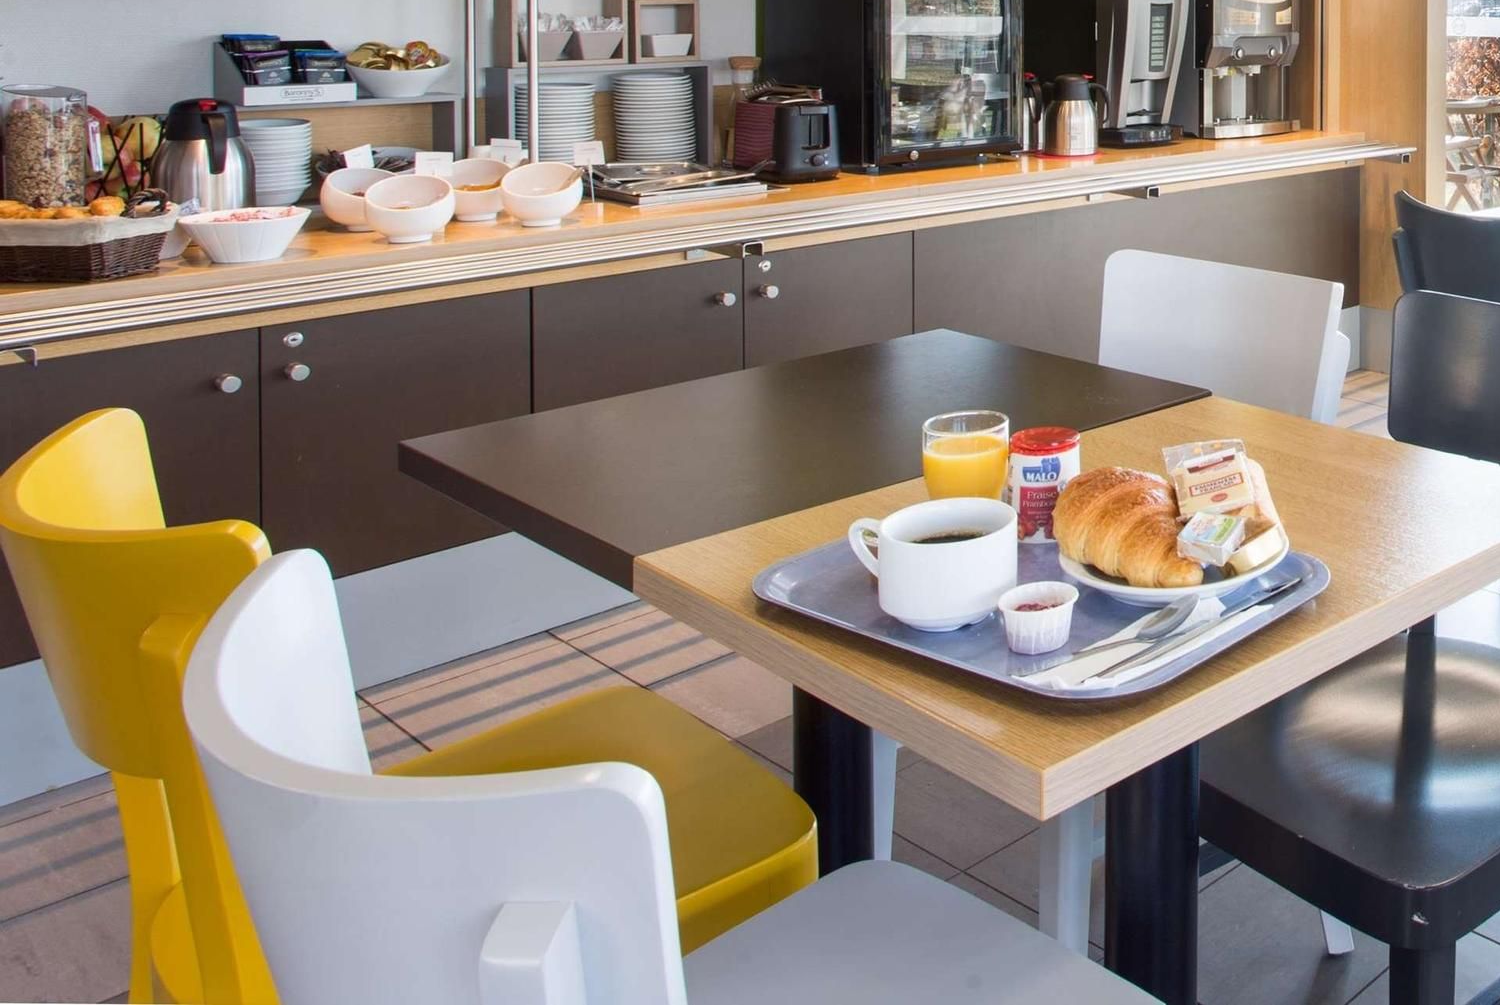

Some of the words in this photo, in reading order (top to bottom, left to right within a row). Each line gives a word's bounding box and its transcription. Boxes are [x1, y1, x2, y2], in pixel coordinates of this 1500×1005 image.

[1026, 471, 1057, 482] MALO
[1027, 491, 1057, 499] Fraise
[1022, 499, 1055, 508] Frambo
